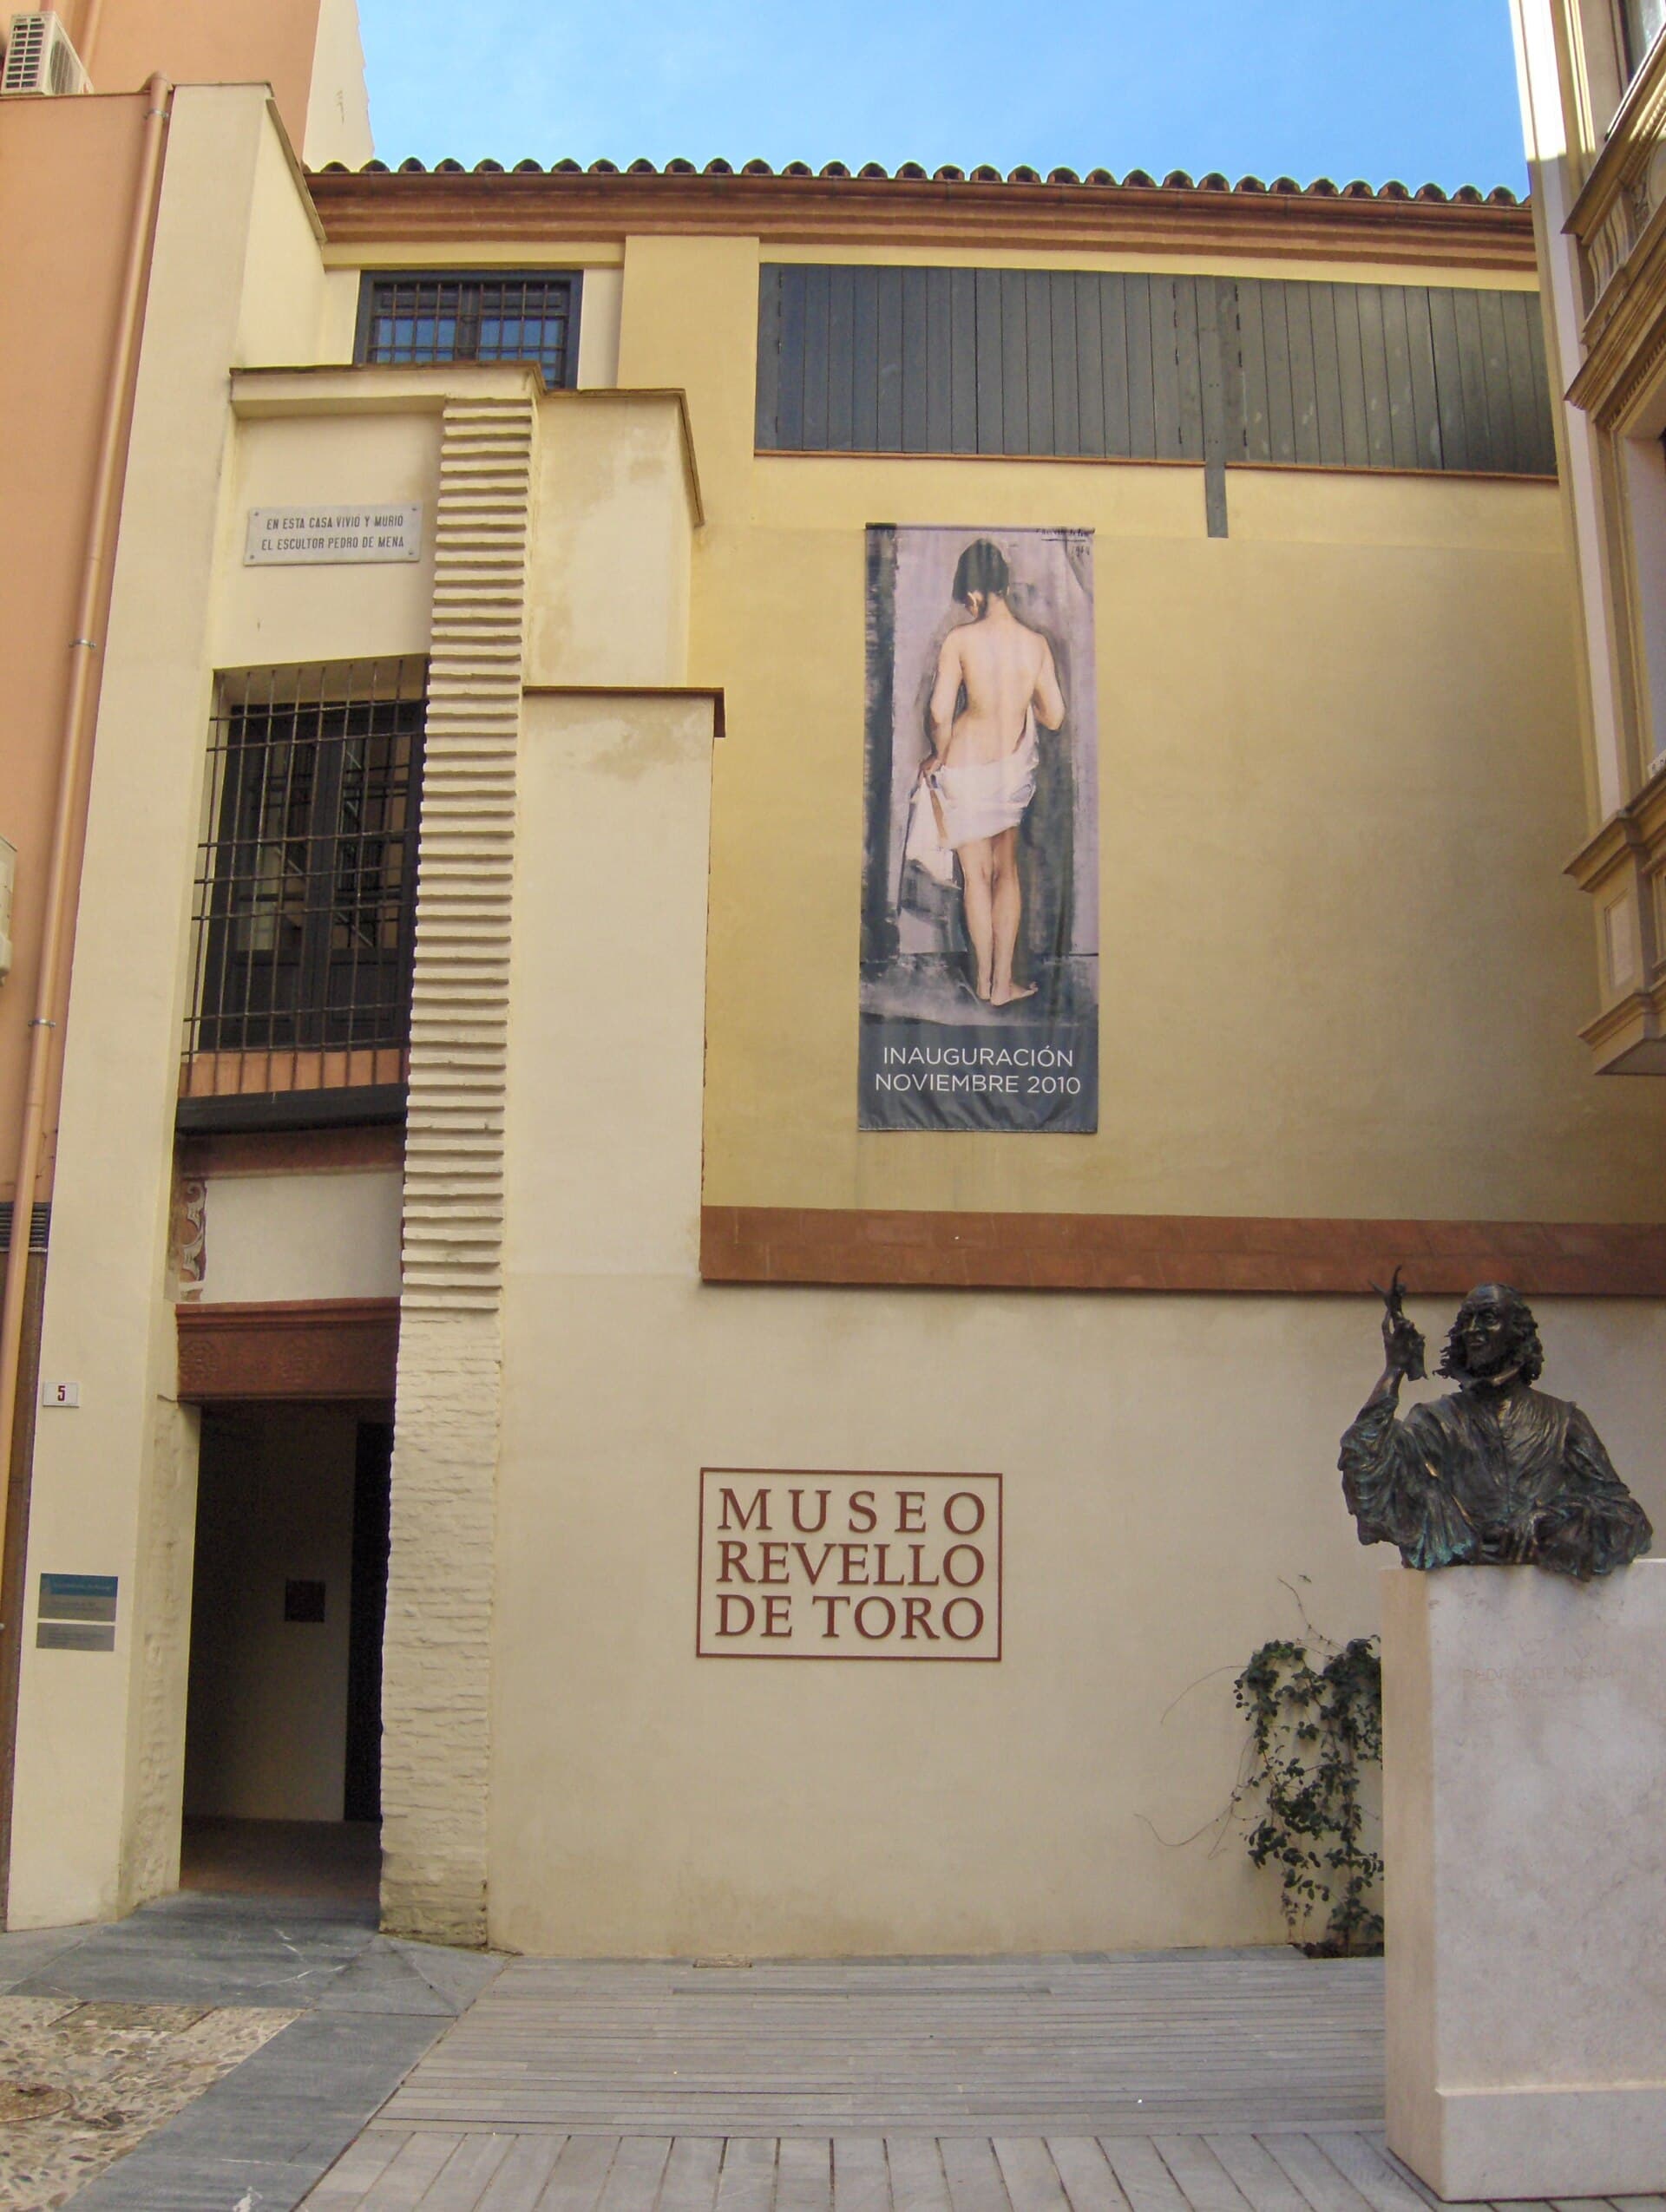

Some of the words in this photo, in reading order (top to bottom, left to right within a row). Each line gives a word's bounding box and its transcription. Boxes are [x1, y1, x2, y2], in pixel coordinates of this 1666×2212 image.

[266, 519, 279, 530] EN
[282, 518, 305, 529] ESTA
[309, 516, 332, 528] CASA
[364, 515, 371, 527] Y
[261, 539, 272, 550] EL
[277, 537, 325, 550] ESCULTOR
[328, 536, 358, 549] PEDRO
[362, 536, 374, 548] DE
[378, 535, 403, 547] MENA
[883, 1045, 1073, 1067] INAUGURACIÓN
[876, 1074, 1020, 1093] NOVIEMBRE
[1026, 1077, 1081, 1095] 2010
[56, 1384, 66, 1402] 5
[717, 1488, 986, 1535] MUSEO
[716, 1541, 985, 1587] REVELLO
[715, 1594, 793, 1638] DE
[812, 1595, 984, 1640] TORO
